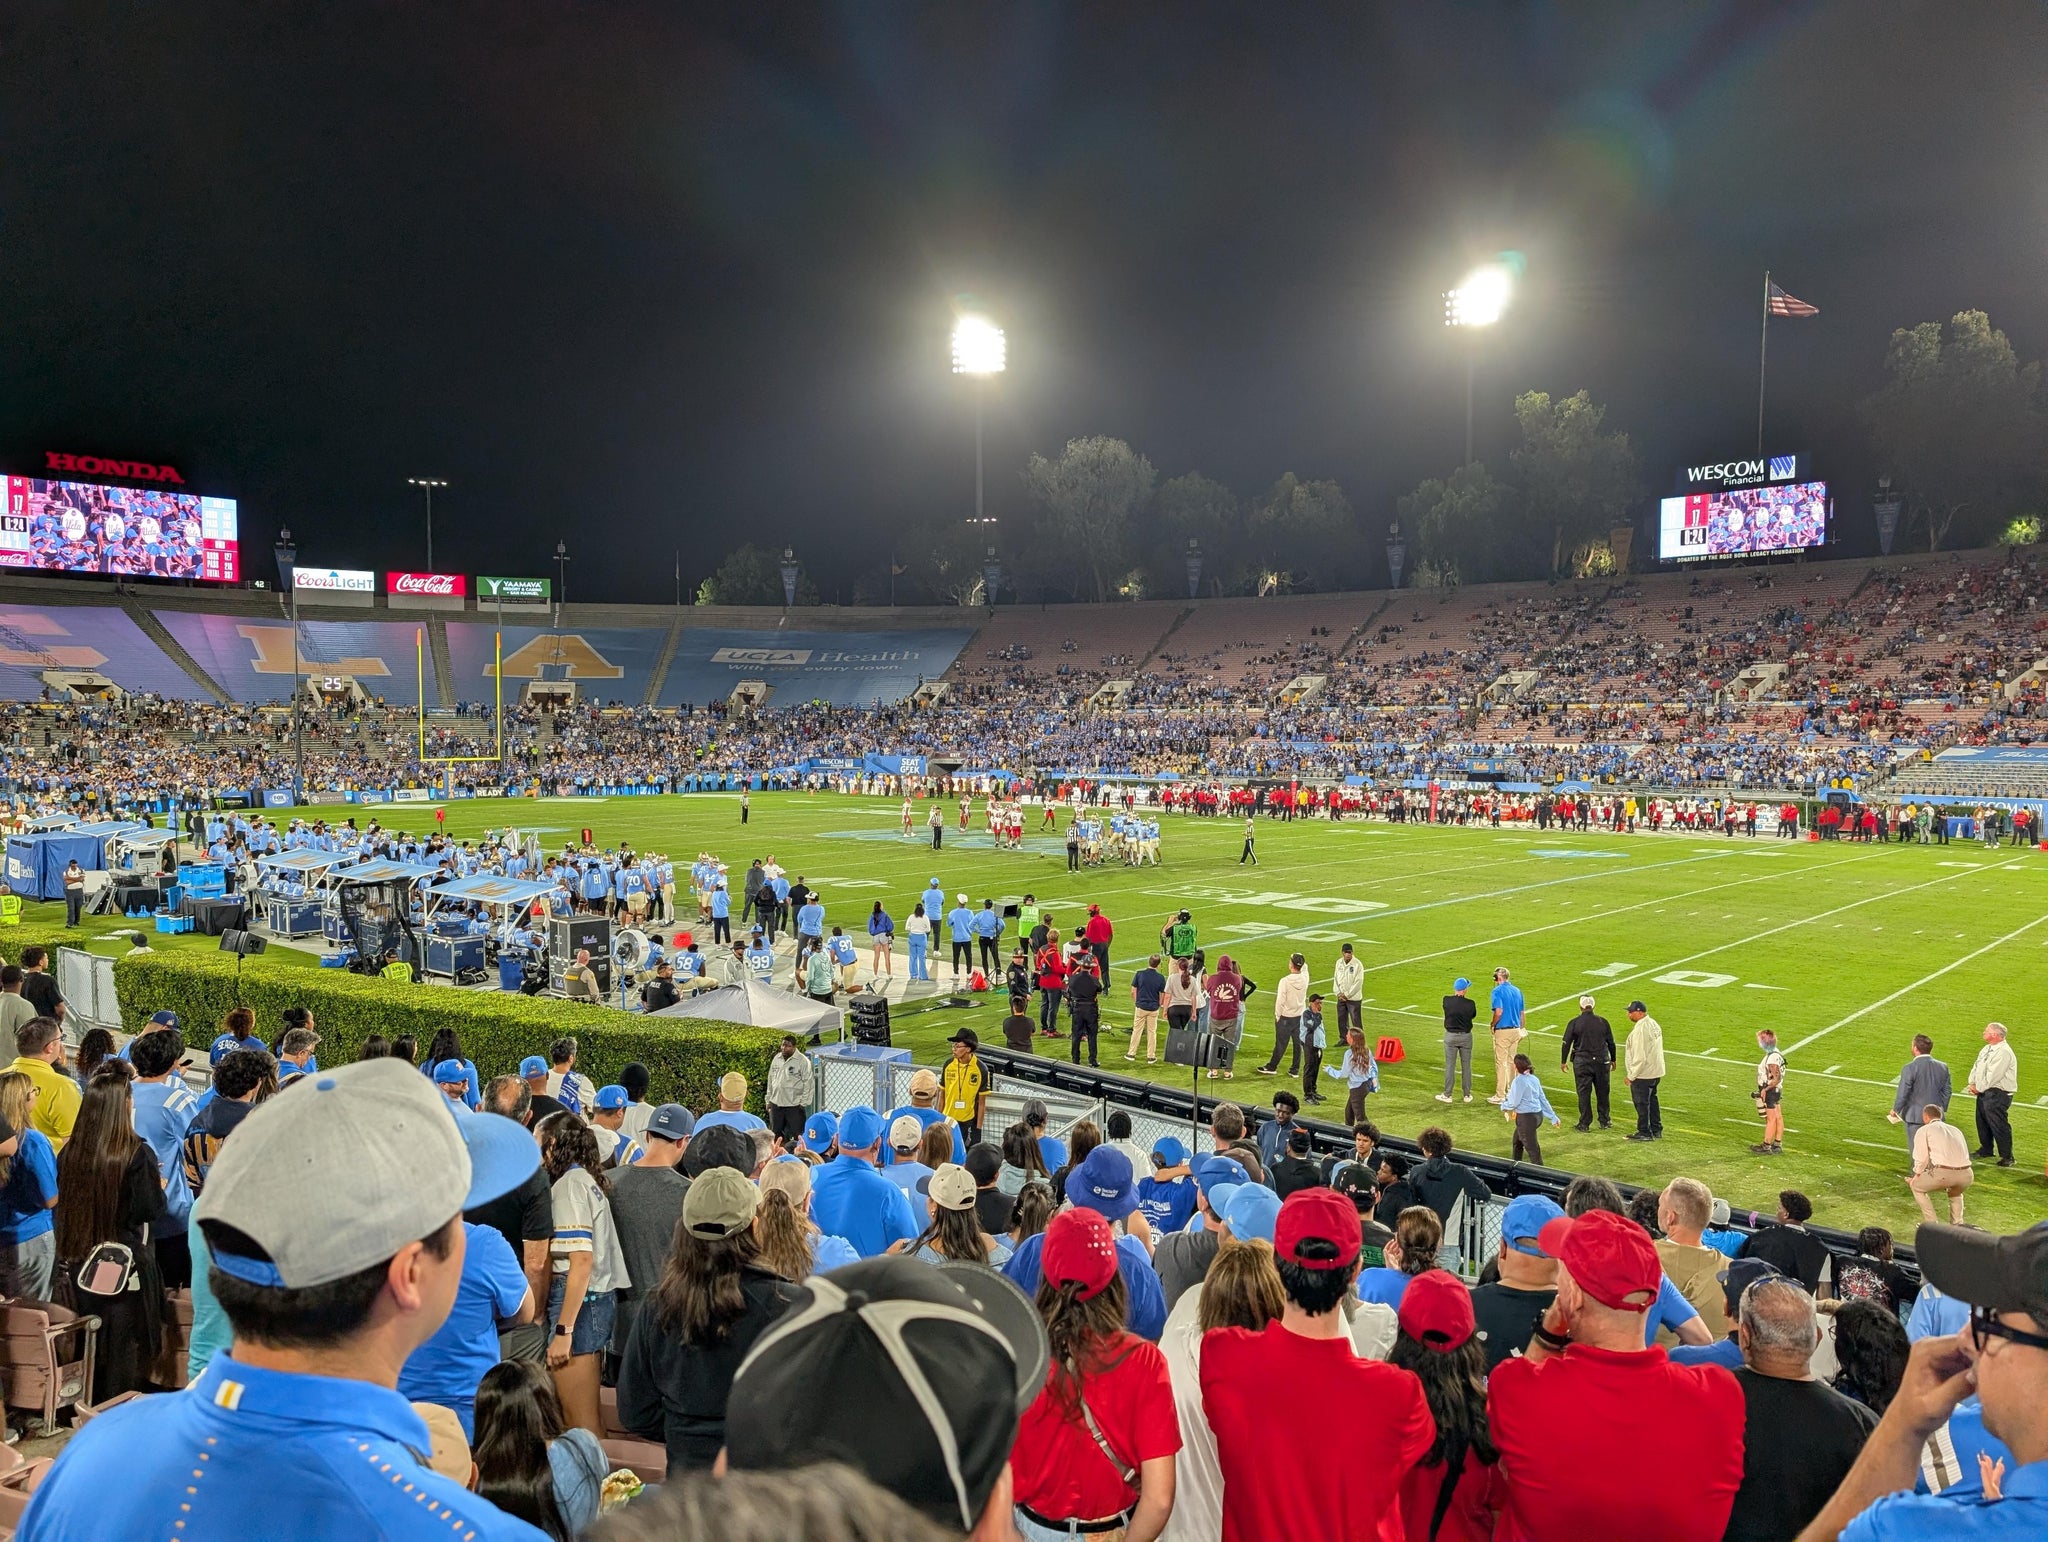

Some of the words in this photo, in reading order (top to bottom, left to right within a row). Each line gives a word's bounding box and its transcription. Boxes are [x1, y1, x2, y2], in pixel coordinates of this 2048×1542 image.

[45, 451, 185, 484] HONDA
[1688, 459, 1765, 482] WESCOM
[1723, 474, 1765, 486] Financial
[13, 494, 24, 511] 17
[4, 517, 24, 531] 0:24
[1691, 509, 1701, 526] 17
[1684, 529, 1704, 545] 0:24
[1770, 548, 1805, 556] FOUNDATION
[254, 580, 265, 588] 42
[295, 573, 335, 588] Coors
[335, 578, 374, 589] LIGHT
[395, 573, 457, 594] Coca-Cola
[727, 651, 796, 661] UCLA
[816, 650, 921, 663] Health
[728, 663, 764, 672] With
[324, 677, 342, 690] 25
[901, 757, 920, 766] SEAT
[900, 766, 920, 774] GEEK
[477, 789, 503, 797] READY
[592, 874, 602, 884] 81
[627, 875, 641, 887] 70
[838, 938, 853, 952] 97
[676, 956, 694, 970] 58
[751, 955, 770, 969] 99
[1582, 962, 1739, 988] 10
[1379, 1039, 1396, 1059] 10
